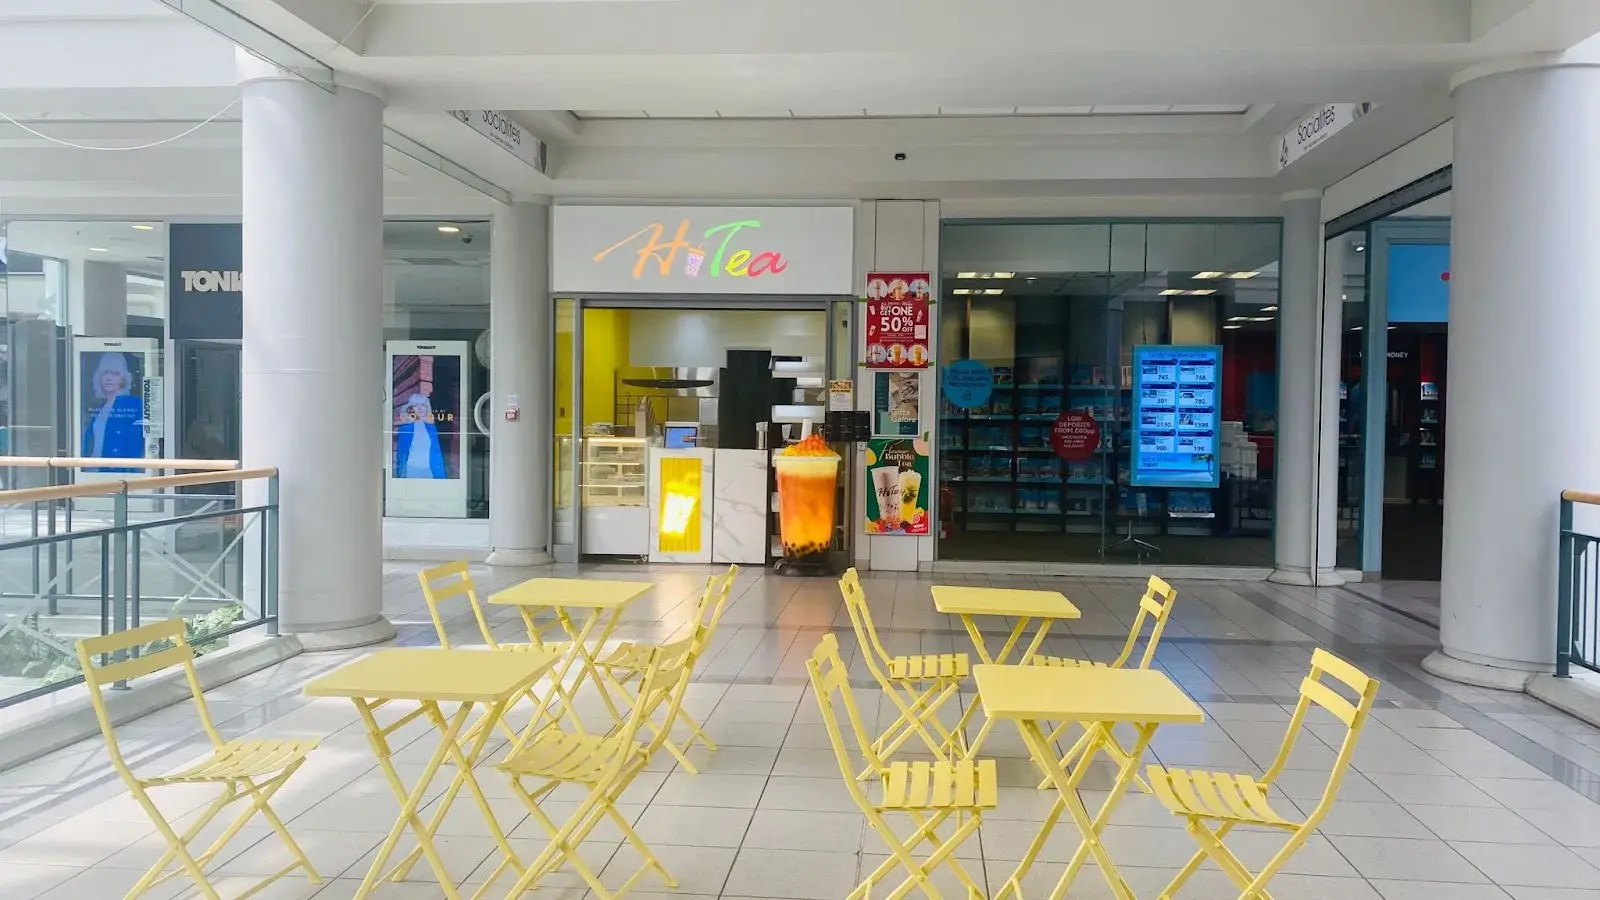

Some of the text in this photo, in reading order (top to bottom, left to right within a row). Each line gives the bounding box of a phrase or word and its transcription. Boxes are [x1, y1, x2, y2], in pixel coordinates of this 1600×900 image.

[1298, 106, 1335, 144] Socialites
[891, 305, 913, 316] ONE
[143, 379, 151, 420] TONI&GUY
[892, 408, 911, 416] Gifts
